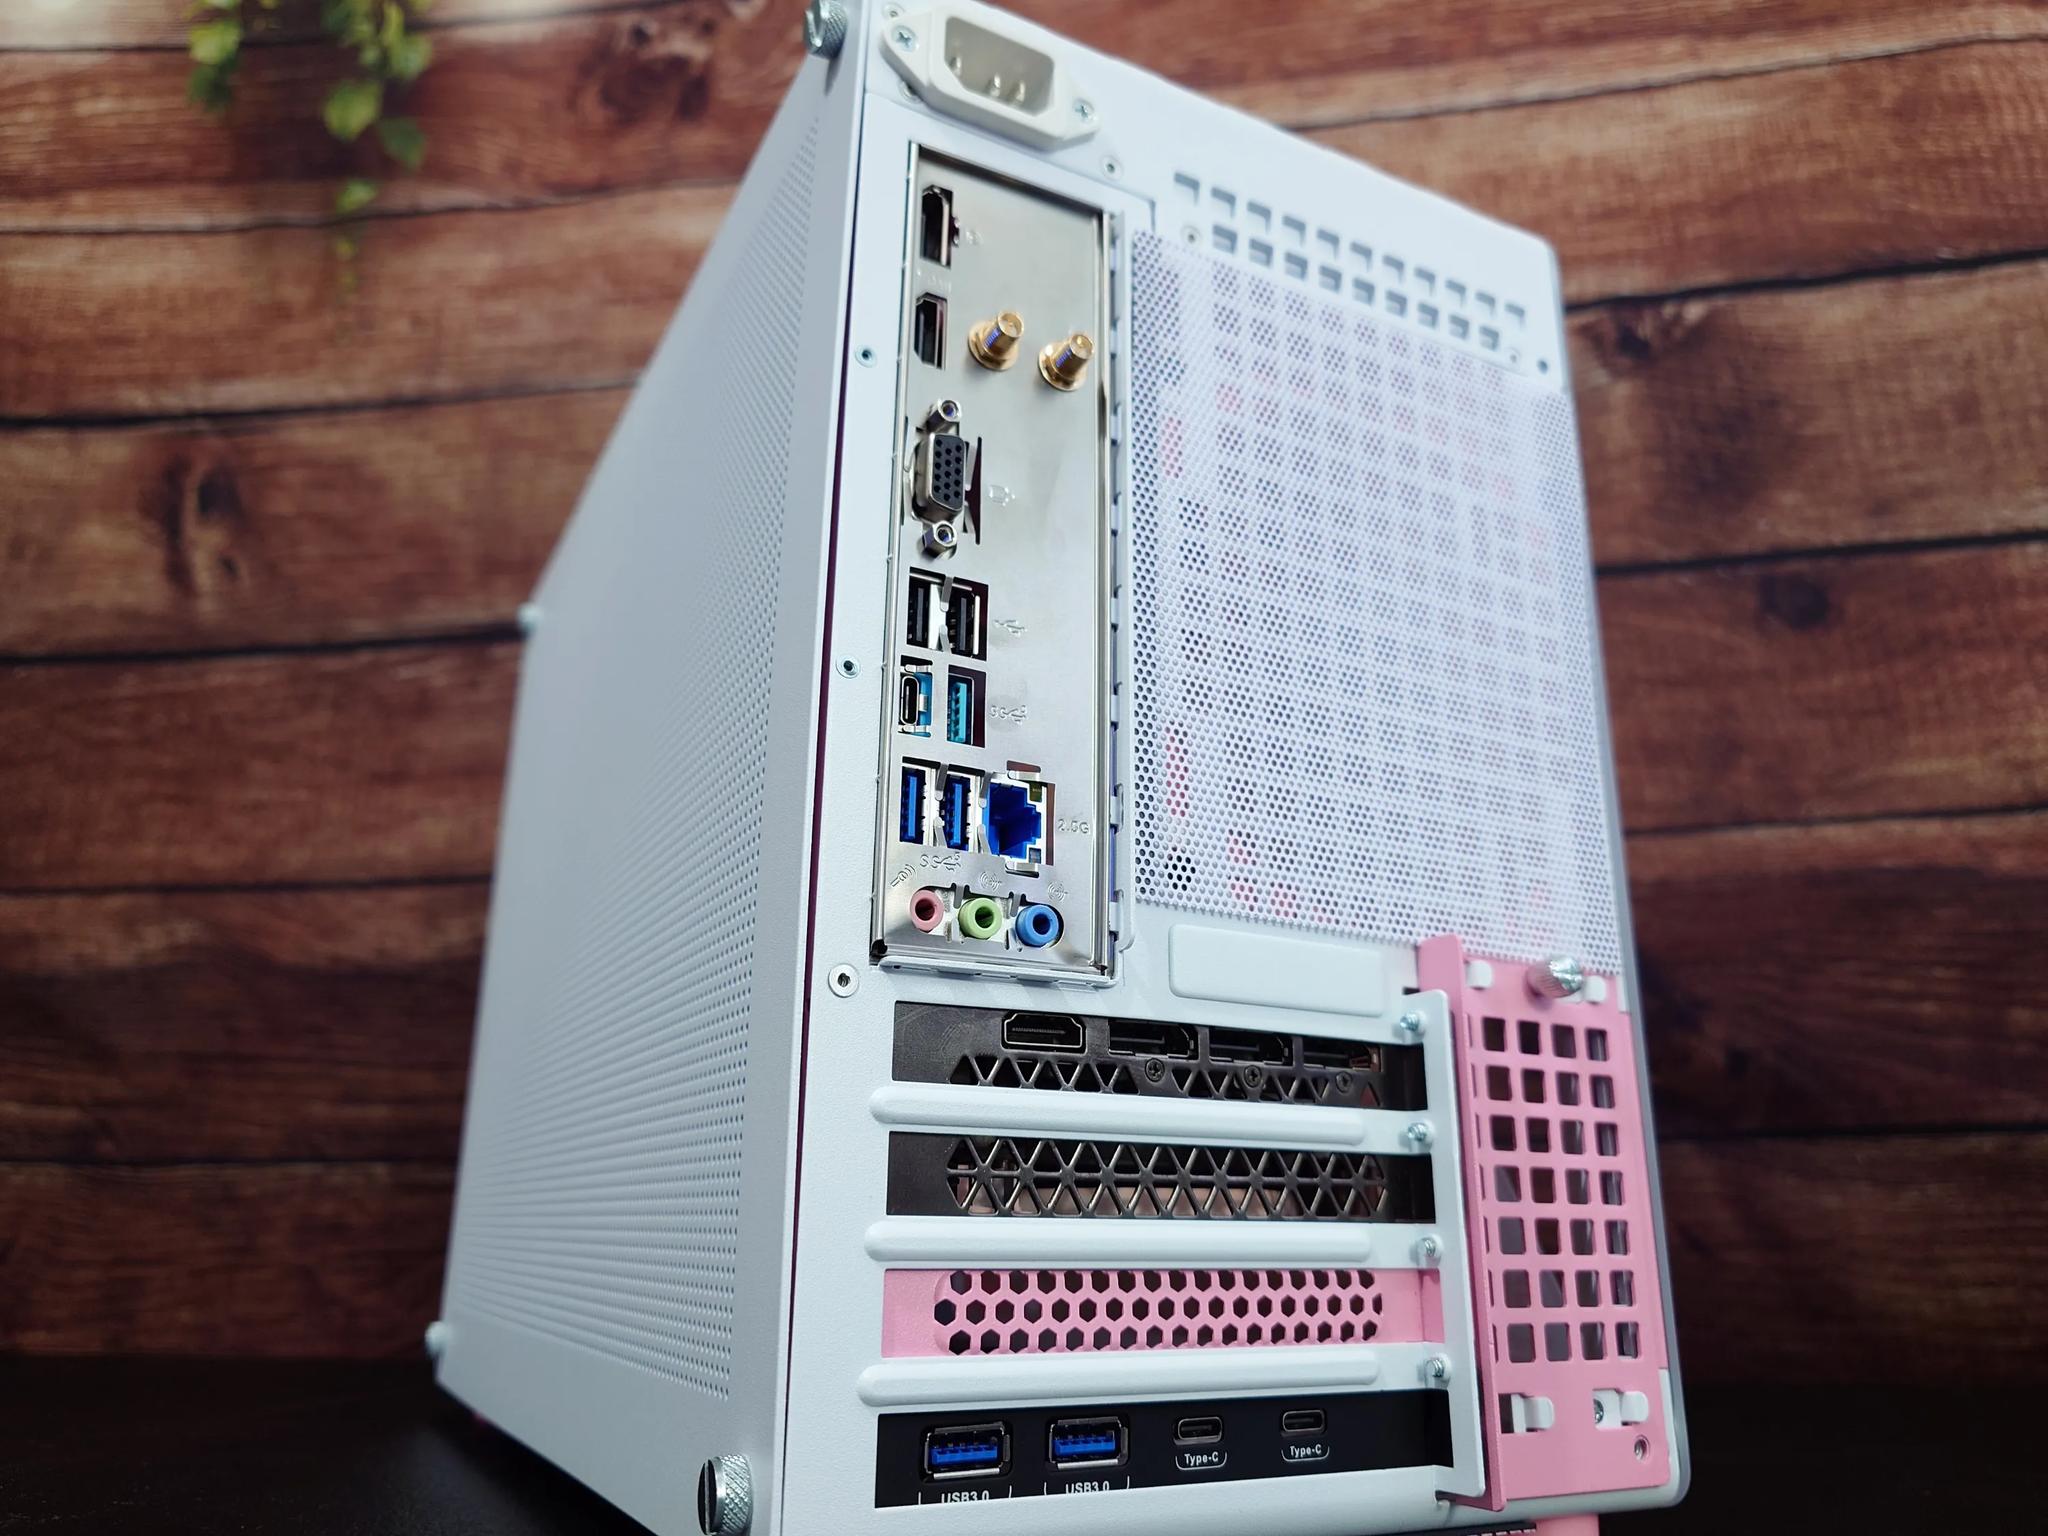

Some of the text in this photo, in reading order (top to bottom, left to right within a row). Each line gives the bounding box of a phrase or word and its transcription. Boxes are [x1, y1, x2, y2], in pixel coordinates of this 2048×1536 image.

[1057, 818, 1089, 834] 2.5G
[1184, 1451, 1219, 1466] Type-C
[1290, 1444, 1322, 1458] Type-C
[1065, 1480, 1110, 1495] USB30
[941, 1490, 990, 1504] USB30
